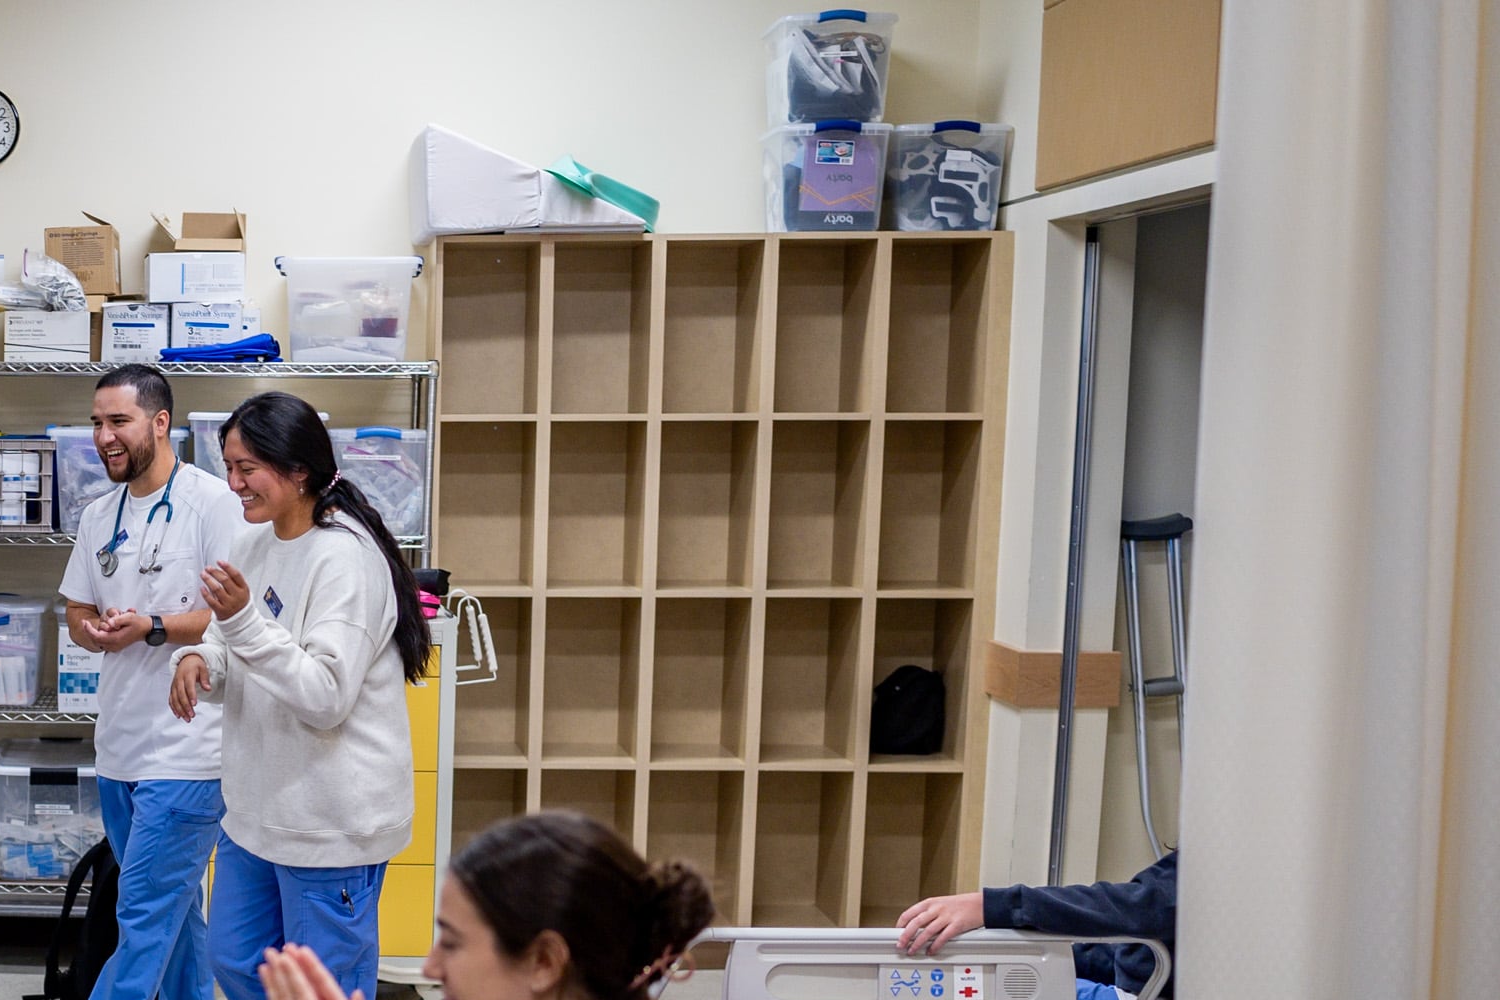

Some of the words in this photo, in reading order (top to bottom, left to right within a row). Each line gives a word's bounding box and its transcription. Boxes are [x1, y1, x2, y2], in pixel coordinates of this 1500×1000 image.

[3, 121, 11, 133] 3
[0, 136, 6, 146] 4
[824, 214, 853, 225] barty
[140, 311, 163, 320] Syringe
[213, 311, 236, 319] Syringe
[114, 327, 119, 336] 3
[188, 326, 194, 335] 3
